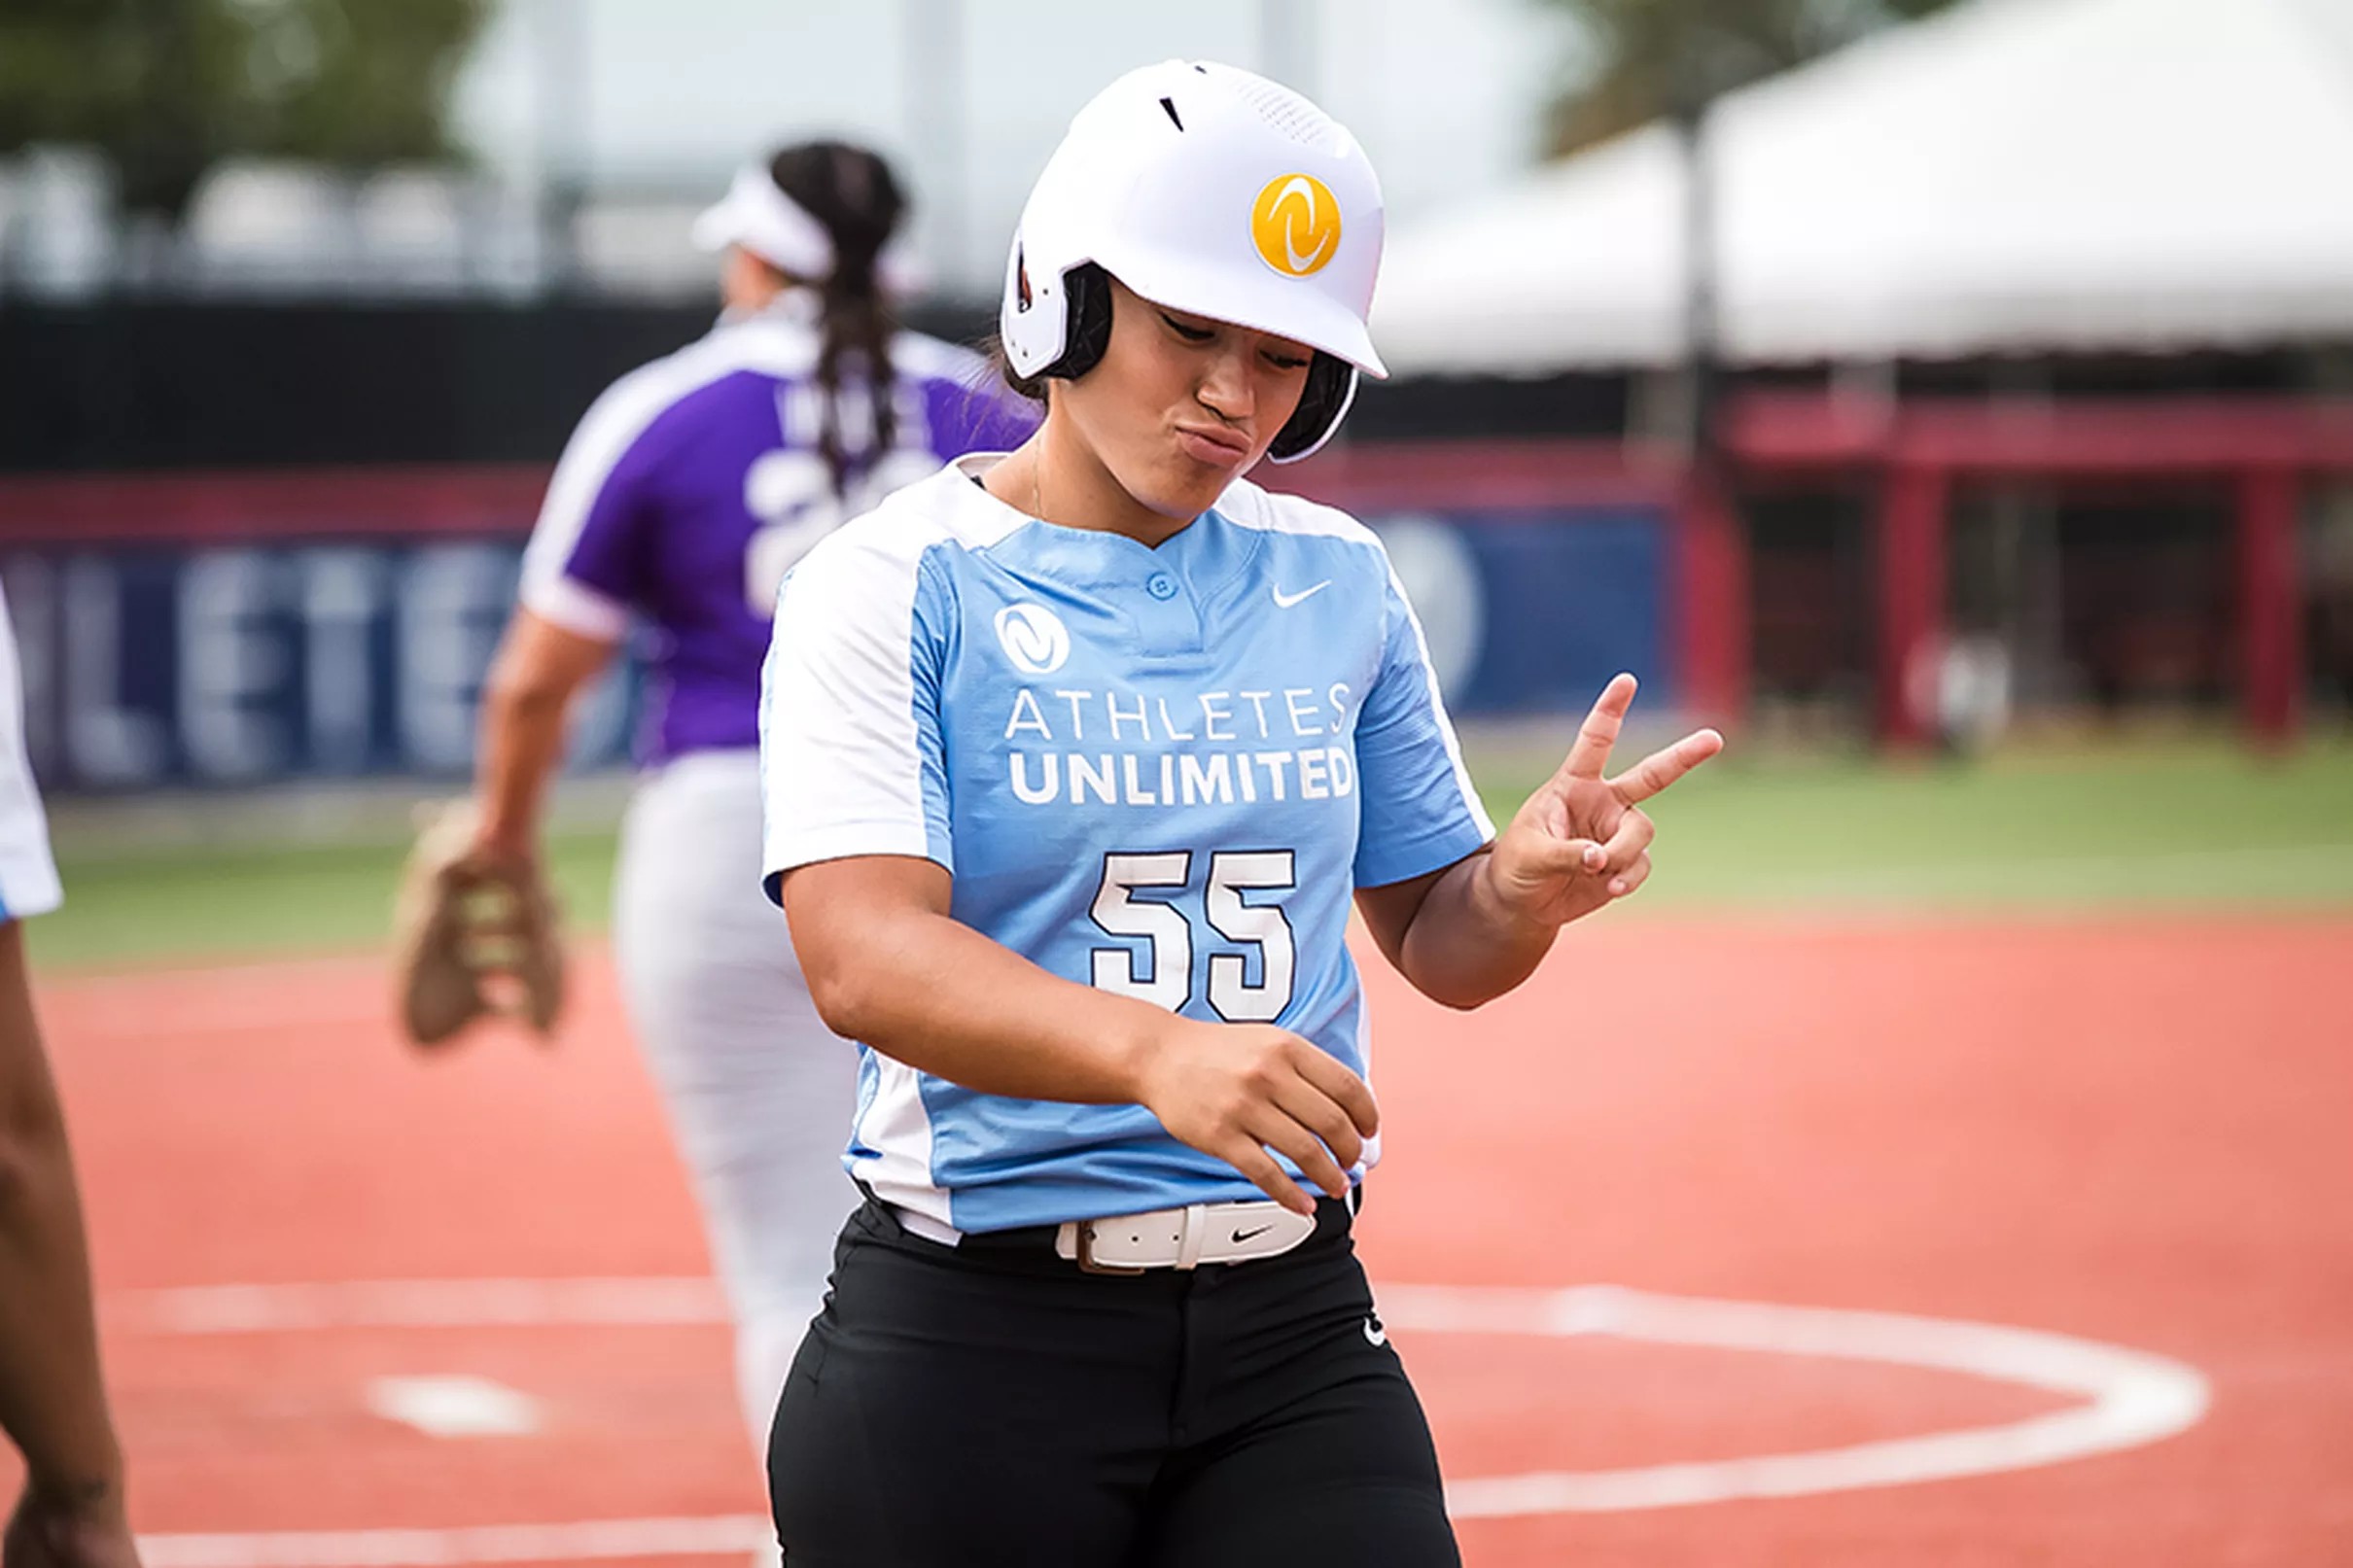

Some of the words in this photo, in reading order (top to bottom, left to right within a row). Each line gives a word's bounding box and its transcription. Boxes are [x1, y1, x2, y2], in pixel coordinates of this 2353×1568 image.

[1004, 682, 1352, 742] ATHLETES
[1009, 747, 1355, 807] UNLIMITED
[1088, 850, 1296, 1024] 55
